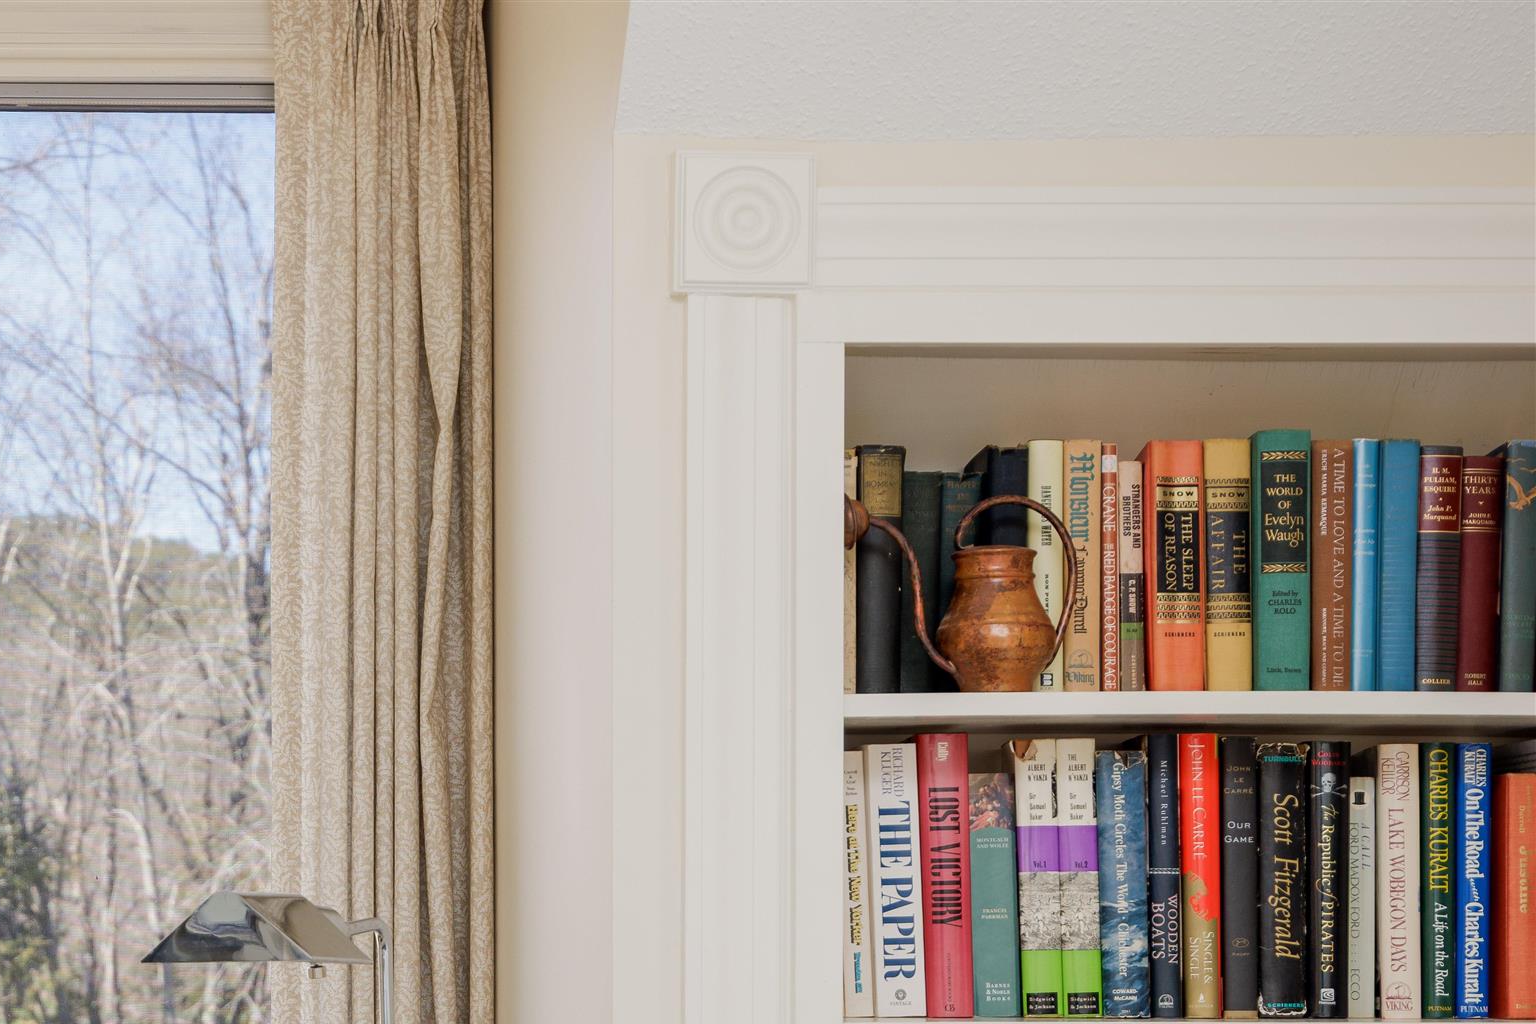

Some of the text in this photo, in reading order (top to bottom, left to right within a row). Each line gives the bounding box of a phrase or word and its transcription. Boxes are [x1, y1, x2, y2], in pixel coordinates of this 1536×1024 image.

[1070, 453, 1095, 542] Monsieur
[1103, 487, 1115, 531] CRANE
[1132, 484, 1140, 532] STRANGERS
[1266, 487, 1303, 496] WORLD
[1273, 473, 1296, 482] THE
[1278, 500, 1292, 509] OF
[1123, 496, 1131, 537] BROTHERS
[1265, 513, 1304, 527] Evelyn
[1266, 529, 1304, 547] Waugh
[1164, 513, 1176, 591] OF REASON
[1181, 513, 1193, 590] THE SLEEP
[1211, 516, 1224, 590] AFFAIR
[1232, 531, 1245, 575] THE
[1103, 551, 1116, 688] RED BADGE OF COURAGE
[1224, 835, 1254, 843] GAME
[1430, 749, 1448, 893] CHARLES KURALT
[927, 786, 962, 927] LOST VICTORY
[1268, 792, 1300, 959] Scott Fitzgerald
[878, 800, 916, 981] THE PAPER
[1388, 808, 1407, 973] LAKE WOBEGON DAYS
[1151, 902, 1165, 960] BOATS
[1167, 894, 1178, 965] WOODEN
[1322, 902, 1333, 973] PIRATES
[1386, 1001, 1413, 1010] VIKING
